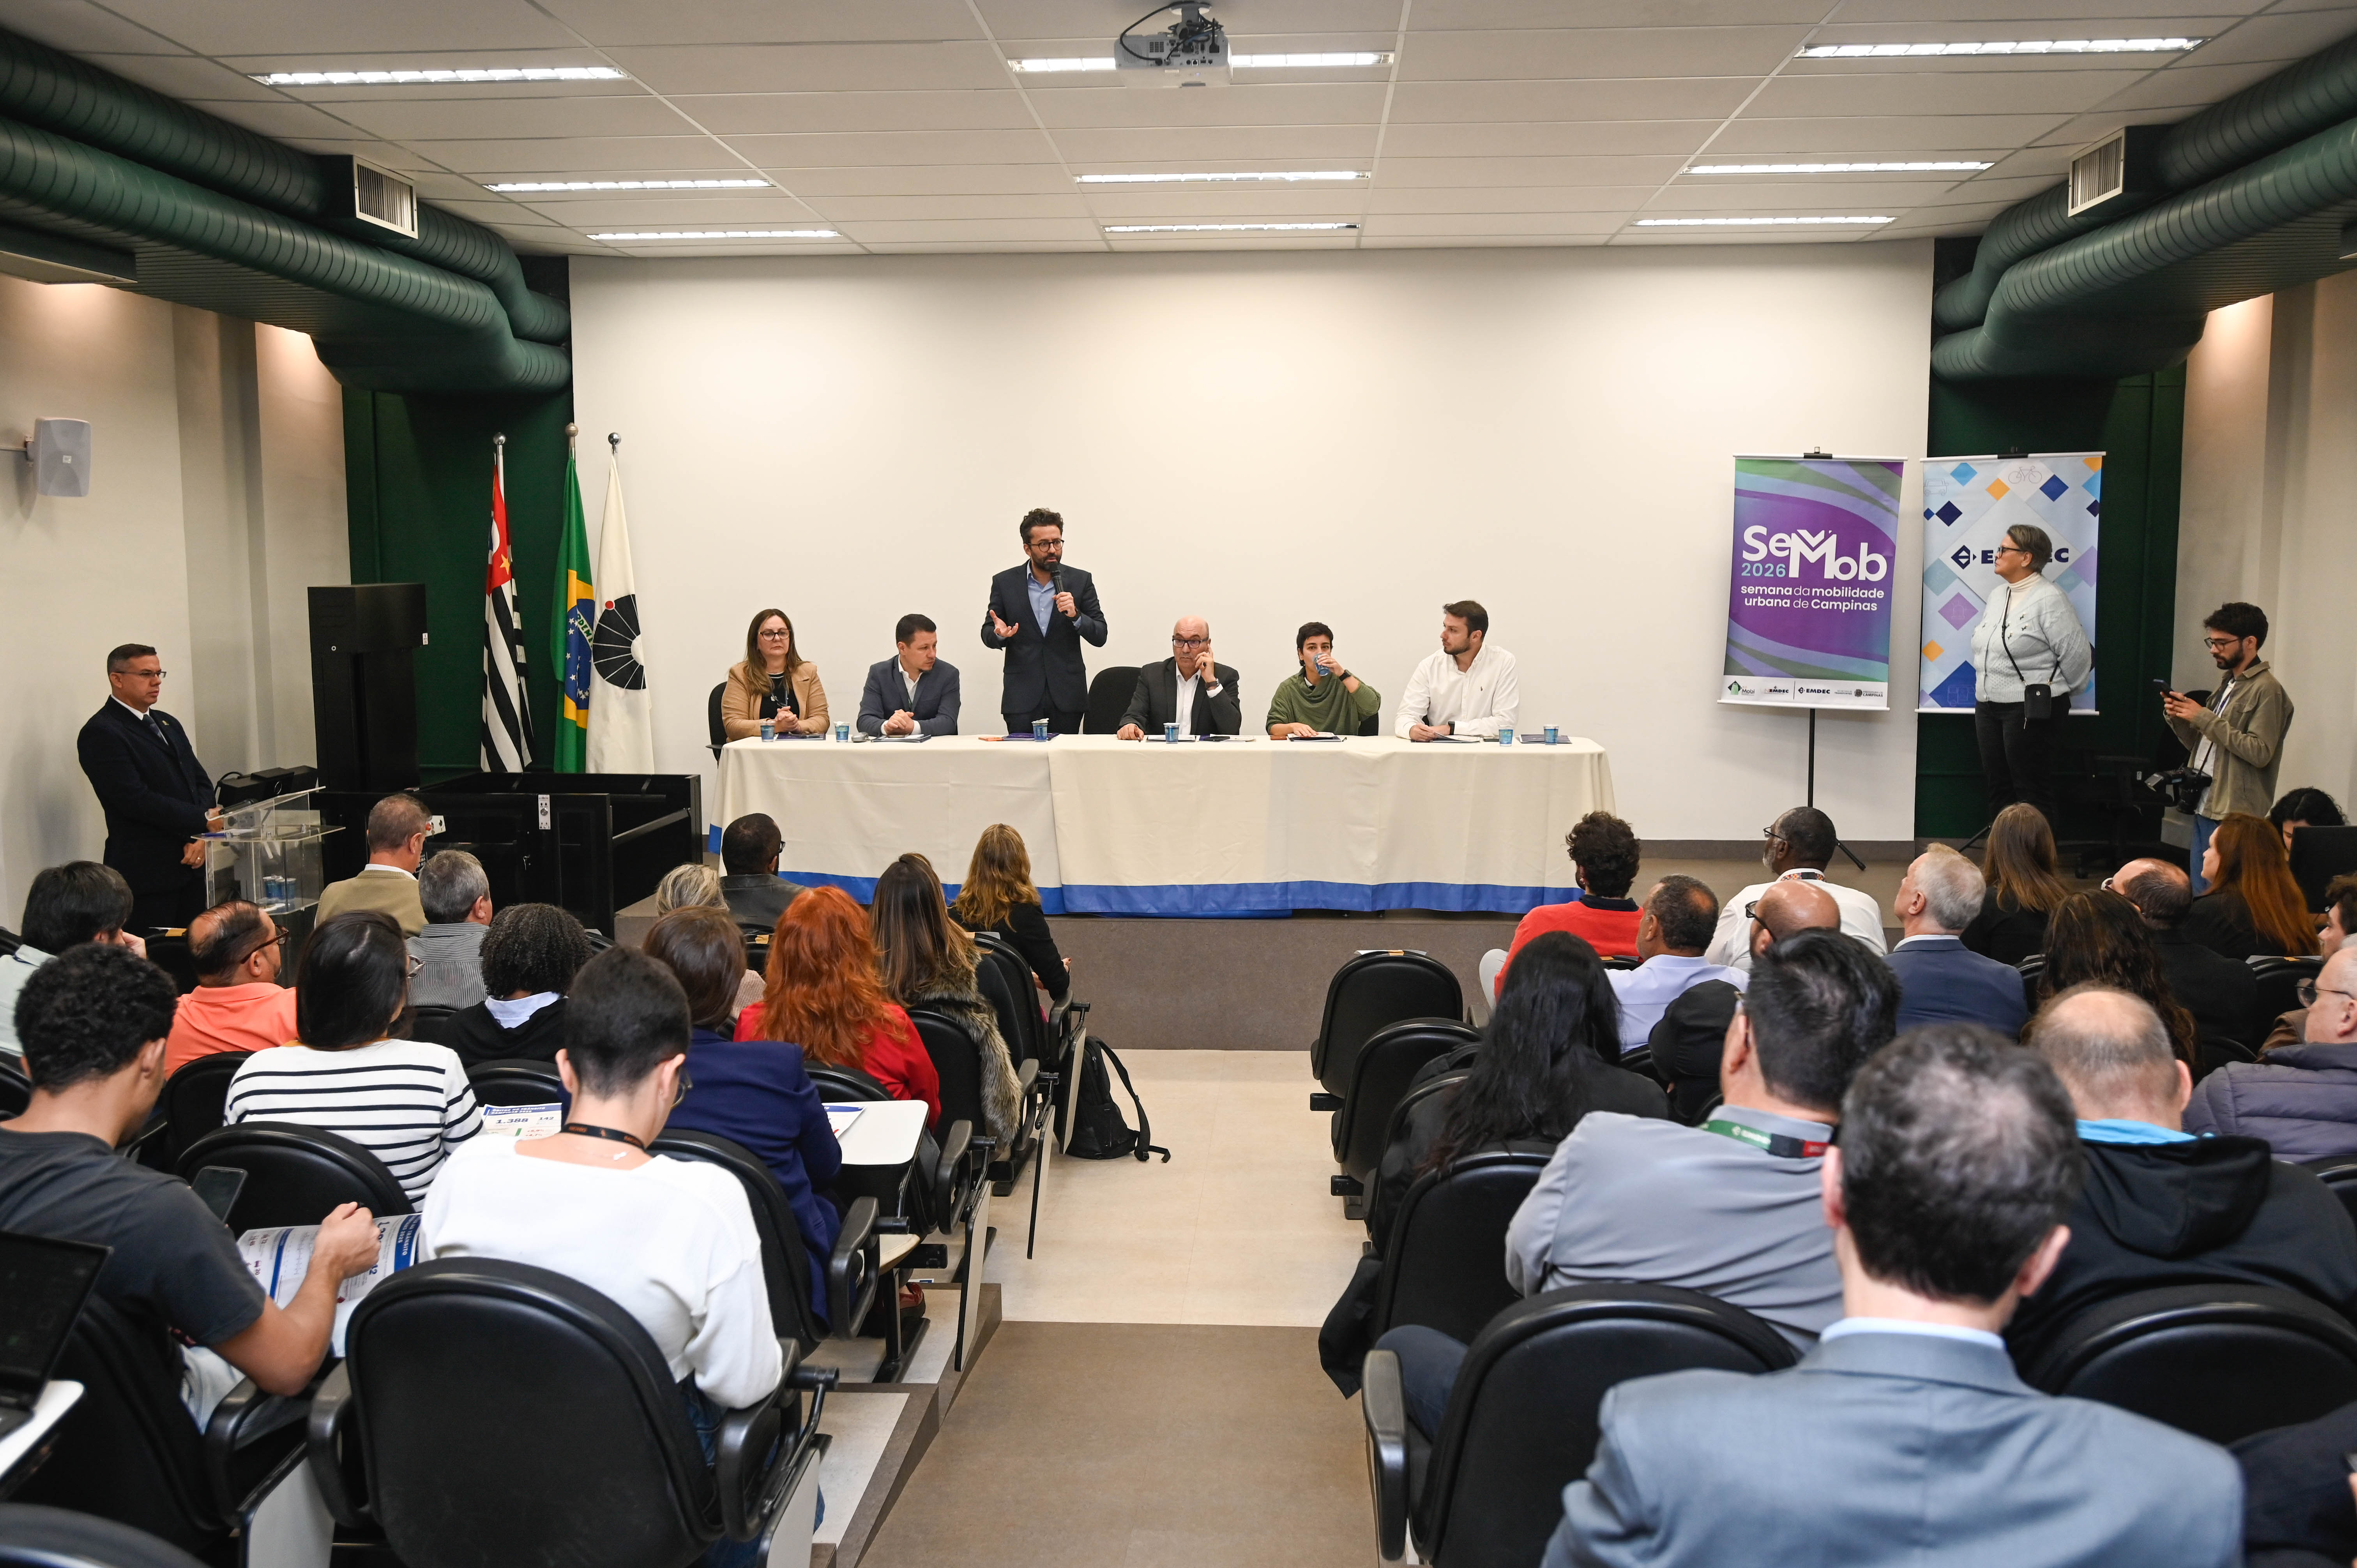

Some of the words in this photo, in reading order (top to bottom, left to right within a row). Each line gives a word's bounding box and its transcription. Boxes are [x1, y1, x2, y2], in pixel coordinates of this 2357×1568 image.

[1741, 563, 1786, 577] 2026
[1740, 586, 1792, 595] semana
[1793, 586, 1810, 596] da
[1812, 586, 1884, 599] mobilidade
[1744, 597, 1790, 607] urbana
[1793, 599, 1809, 608] de
[1811, 599, 1877, 613] Campinas
